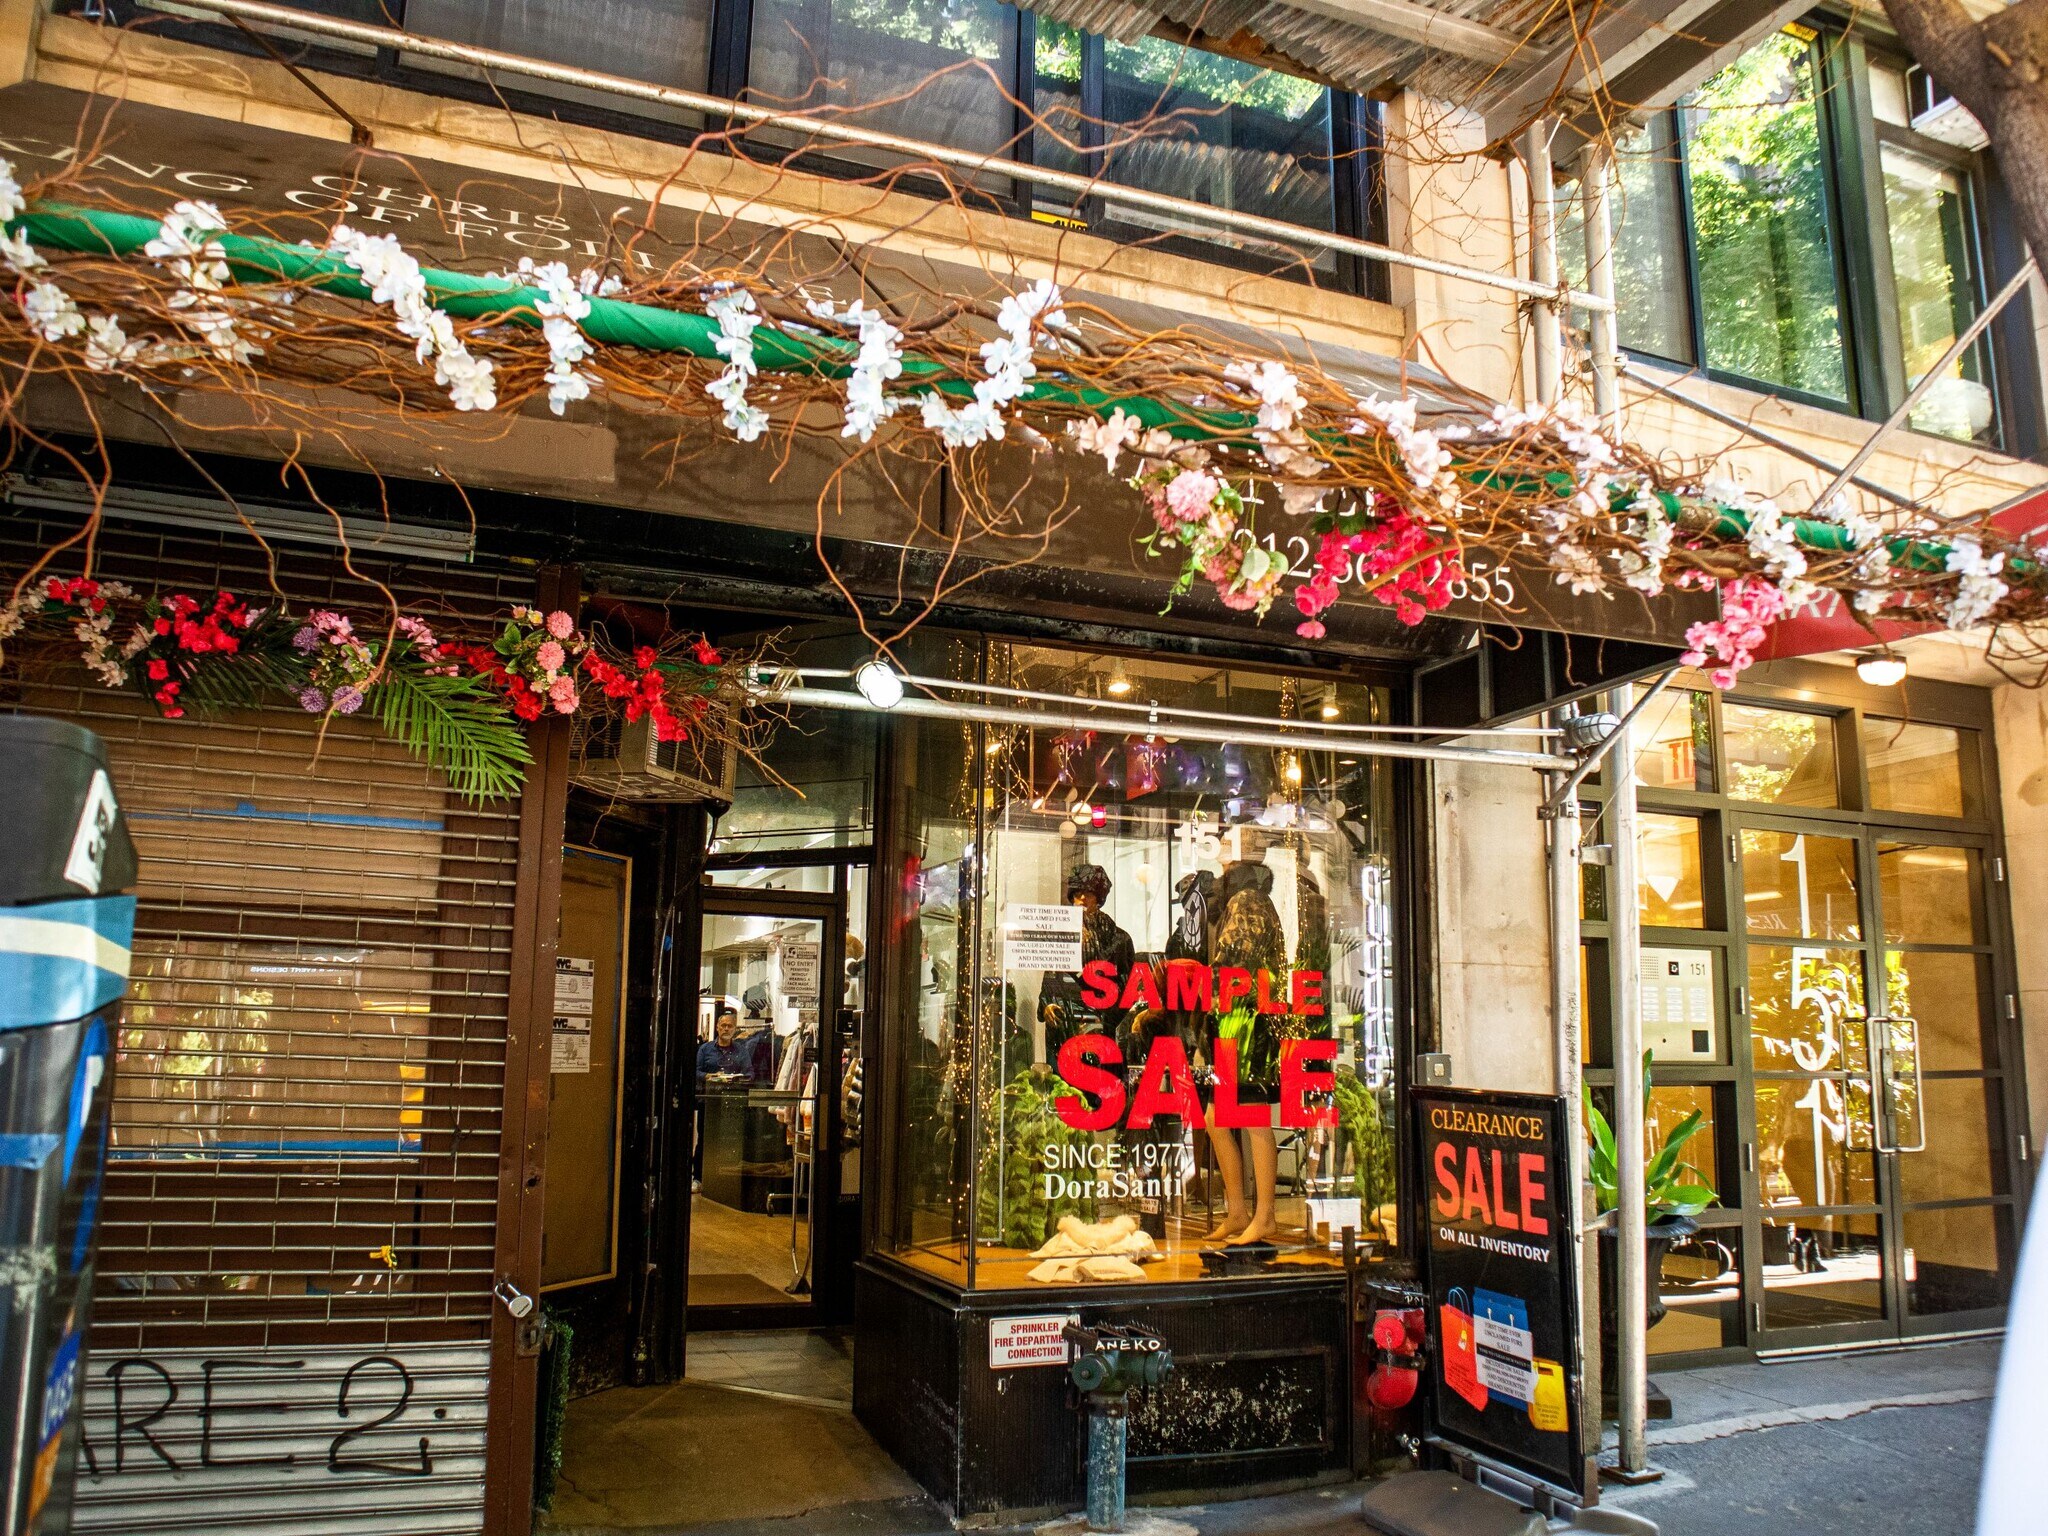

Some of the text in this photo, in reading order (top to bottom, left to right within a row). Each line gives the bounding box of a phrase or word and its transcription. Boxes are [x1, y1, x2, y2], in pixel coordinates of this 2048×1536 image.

[285, 190, 419, 223] OF
[311, 174, 572, 232] CHRIS
[1691, 963, 1705, 976] 151
[1081, 960, 1324, 1016] SAMPLE
[1054, 1034, 1340, 1131] SALE
[1431, 1108, 1544, 1141] CLEARANCE
[1043, 1143, 1184, 1169] SINCE 1977
[1434, 1141, 1548, 1236] SALE
[1440, 1227, 1550, 1263] ON ALL INVENTORY
[994, 1334, 1067, 1348] FIRE DEPARTME
[1010, 1322, 1058, 1335] SPRINKLER
[1095, 1339, 1161, 1351] ANEKO
[1008, 1347, 1062, 1359] CONNECTION
